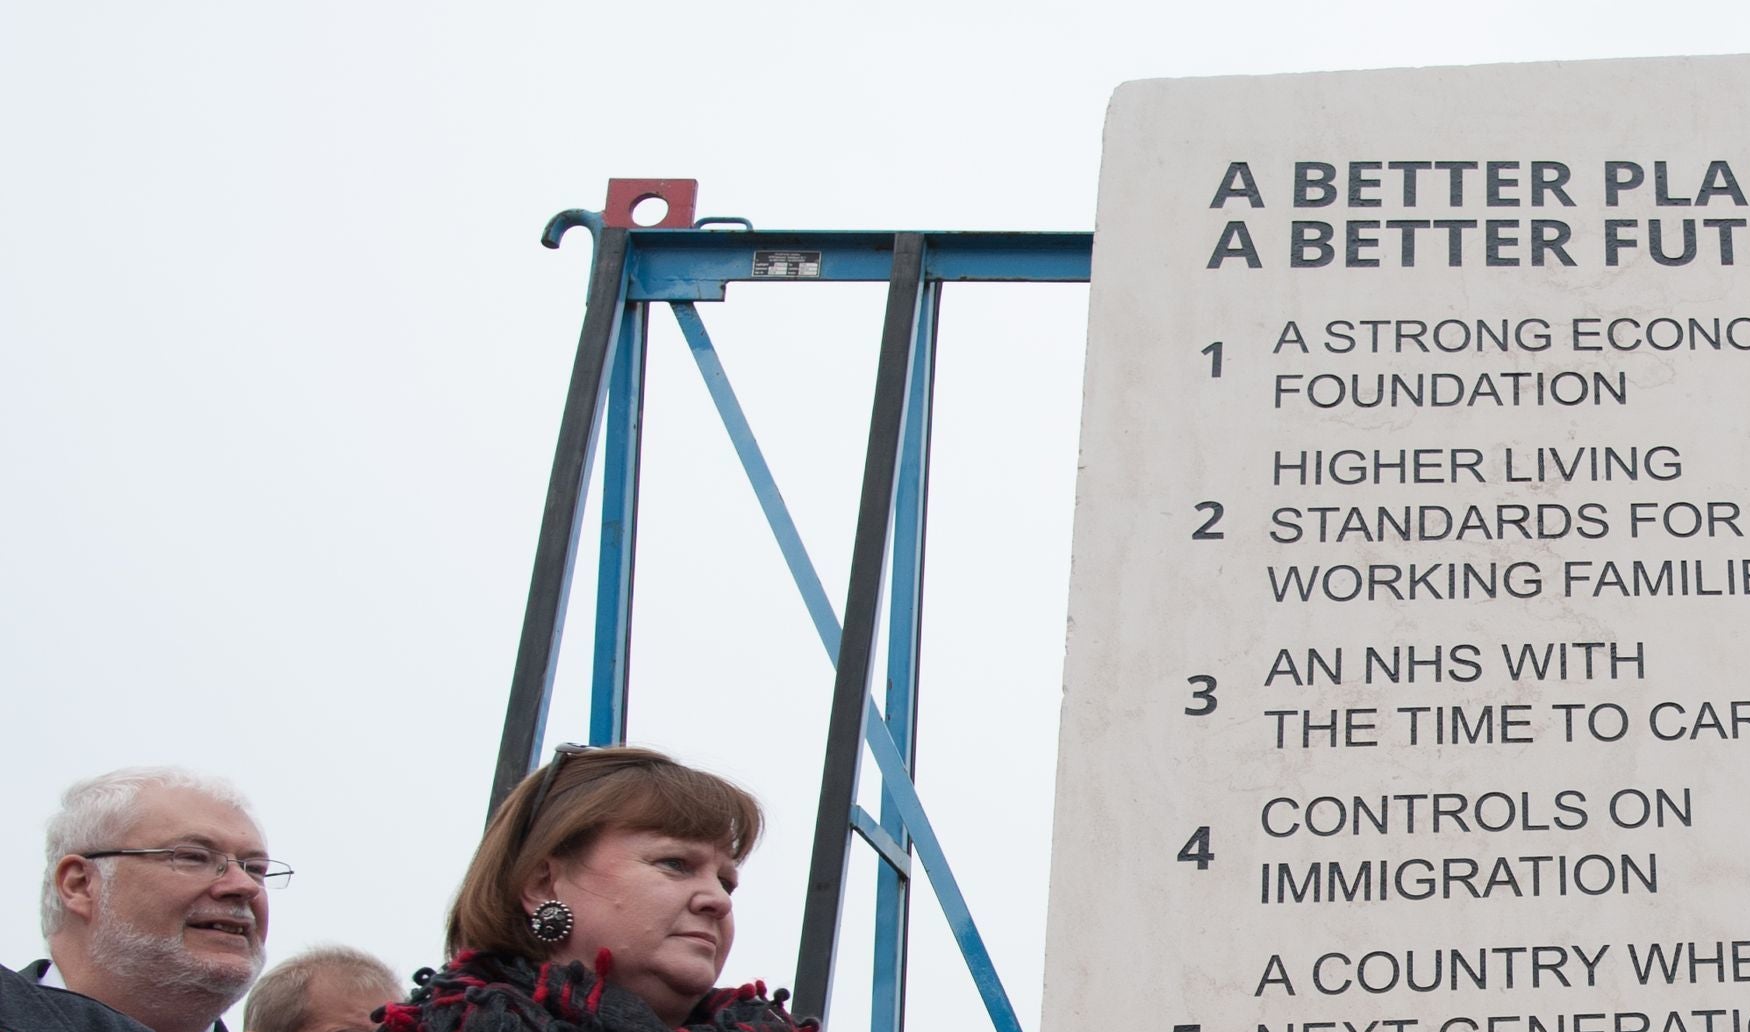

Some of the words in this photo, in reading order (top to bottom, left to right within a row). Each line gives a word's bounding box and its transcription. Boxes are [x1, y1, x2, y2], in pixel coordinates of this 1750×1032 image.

[1209, 162, 1264, 208] A
[1294, 161, 1576, 207] BETTER
[1207, 221, 1262, 269] A
[1291, 219, 1577, 268] BETTER
[1273, 321, 1309, 353] A
[1324, 319, 1551, 353] STRONG
[1201, 342, 1223, 377] 1
[1275, 372, 1626, 408] FOUNDATION
[1274, 449, 1486, 485] HIGHER
[1506, 446, 1681, 482] LIVING
[1192, 501, 1224, 540] 2
[1270, 503, 1609, 543] STANDARDS
[1631, 502, 1744, 538] FOR
[1267, 562, 1542, 602] WORKING
[1264, 648, 1342, 686] AN
[1366, 644, 1482, 684] NHS
[1501, 642, 1644, 681] WITH
[1185, 675, 1217, 716] 3
[1264, 708, 1377, 748] THE
[1397, 706, 1532, 745] TIME
[1553, 703, 1628, 742] TO
[1262, 790, 1588, 837] CONTROLS
[1610, 788, 1691, 829] ON
[1177, 826, 1214, 870] 4
[1262, 854, 1657, 904] IMMIGRATION
[1254, 955, 1296, 997] A
[1313, 945, 1610, 995] COUNTRY
